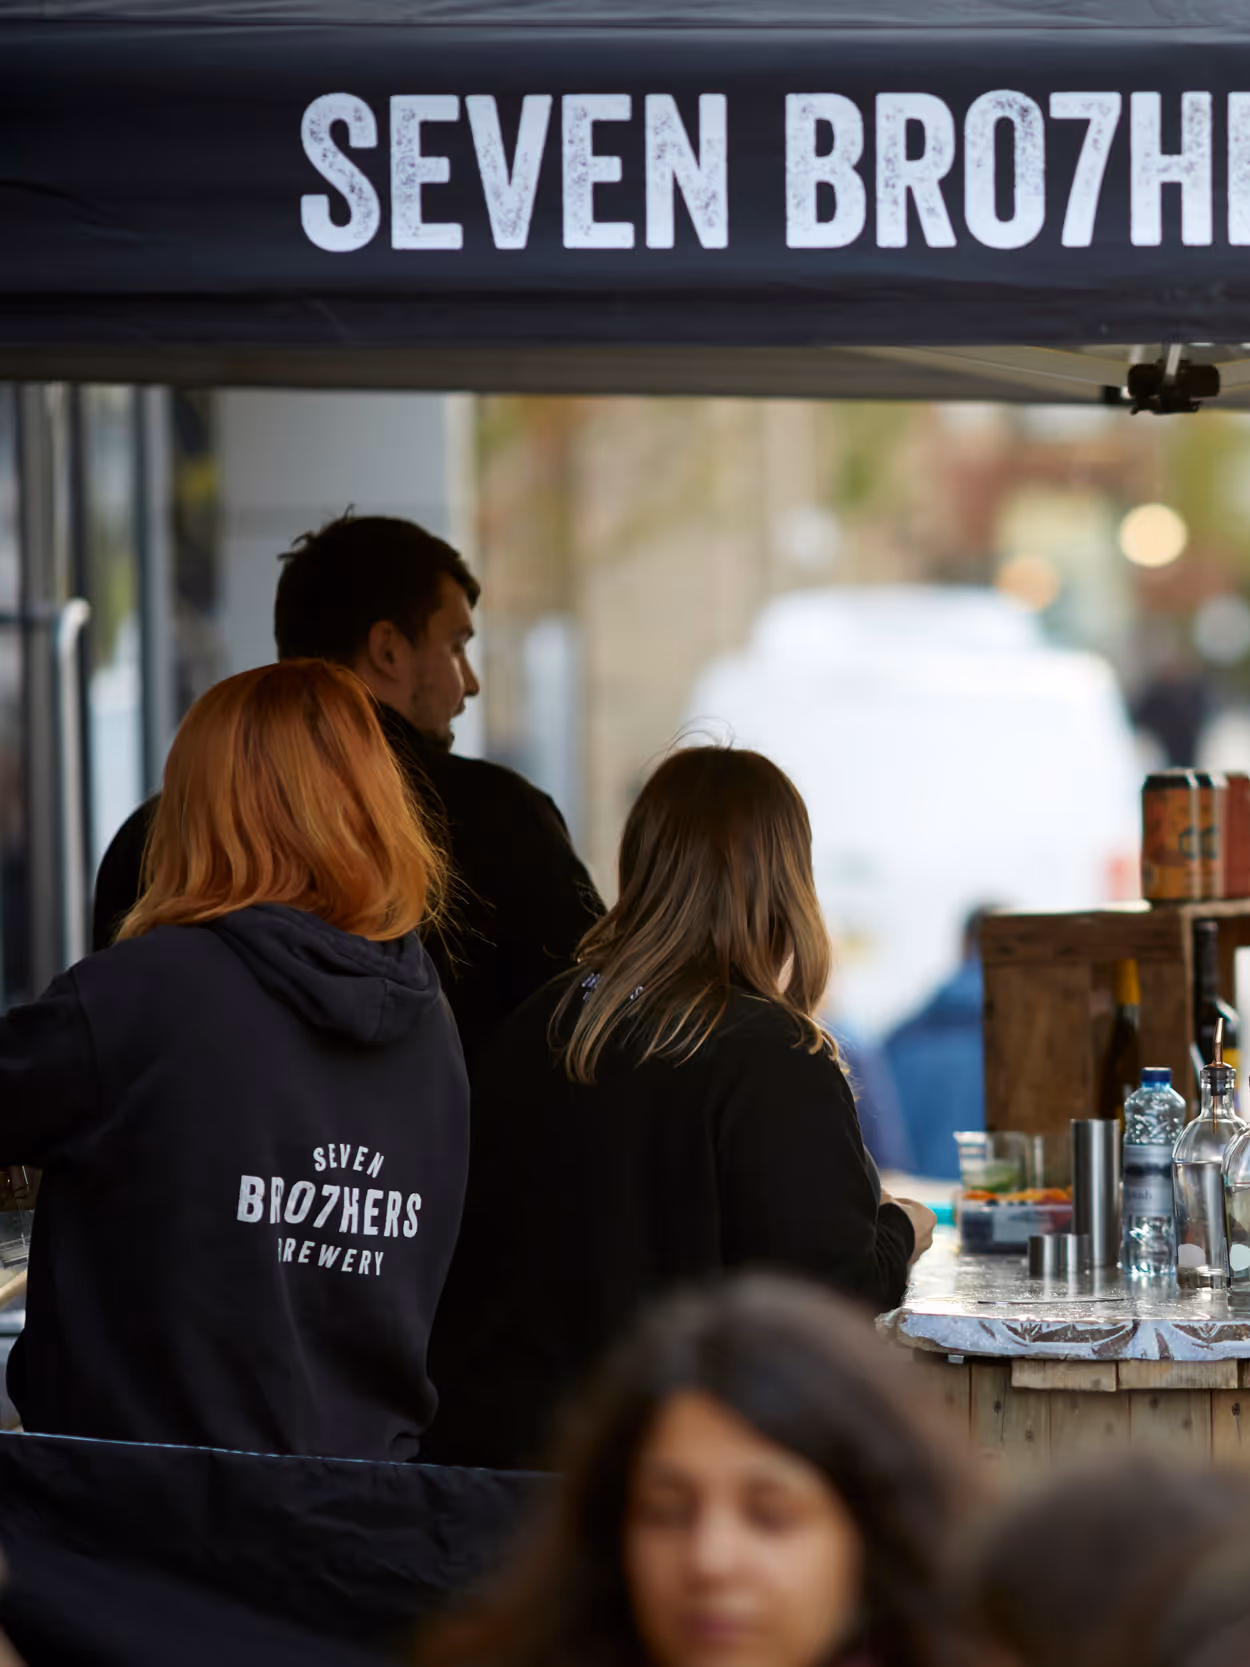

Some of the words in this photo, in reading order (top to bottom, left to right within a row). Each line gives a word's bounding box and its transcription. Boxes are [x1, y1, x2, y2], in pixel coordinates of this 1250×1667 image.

[300, 92, 730, 252] SEVEN
[312, 1143, 385, 1178] SEVEN
[236, 1174, 422, 1238] BRO7HERS
